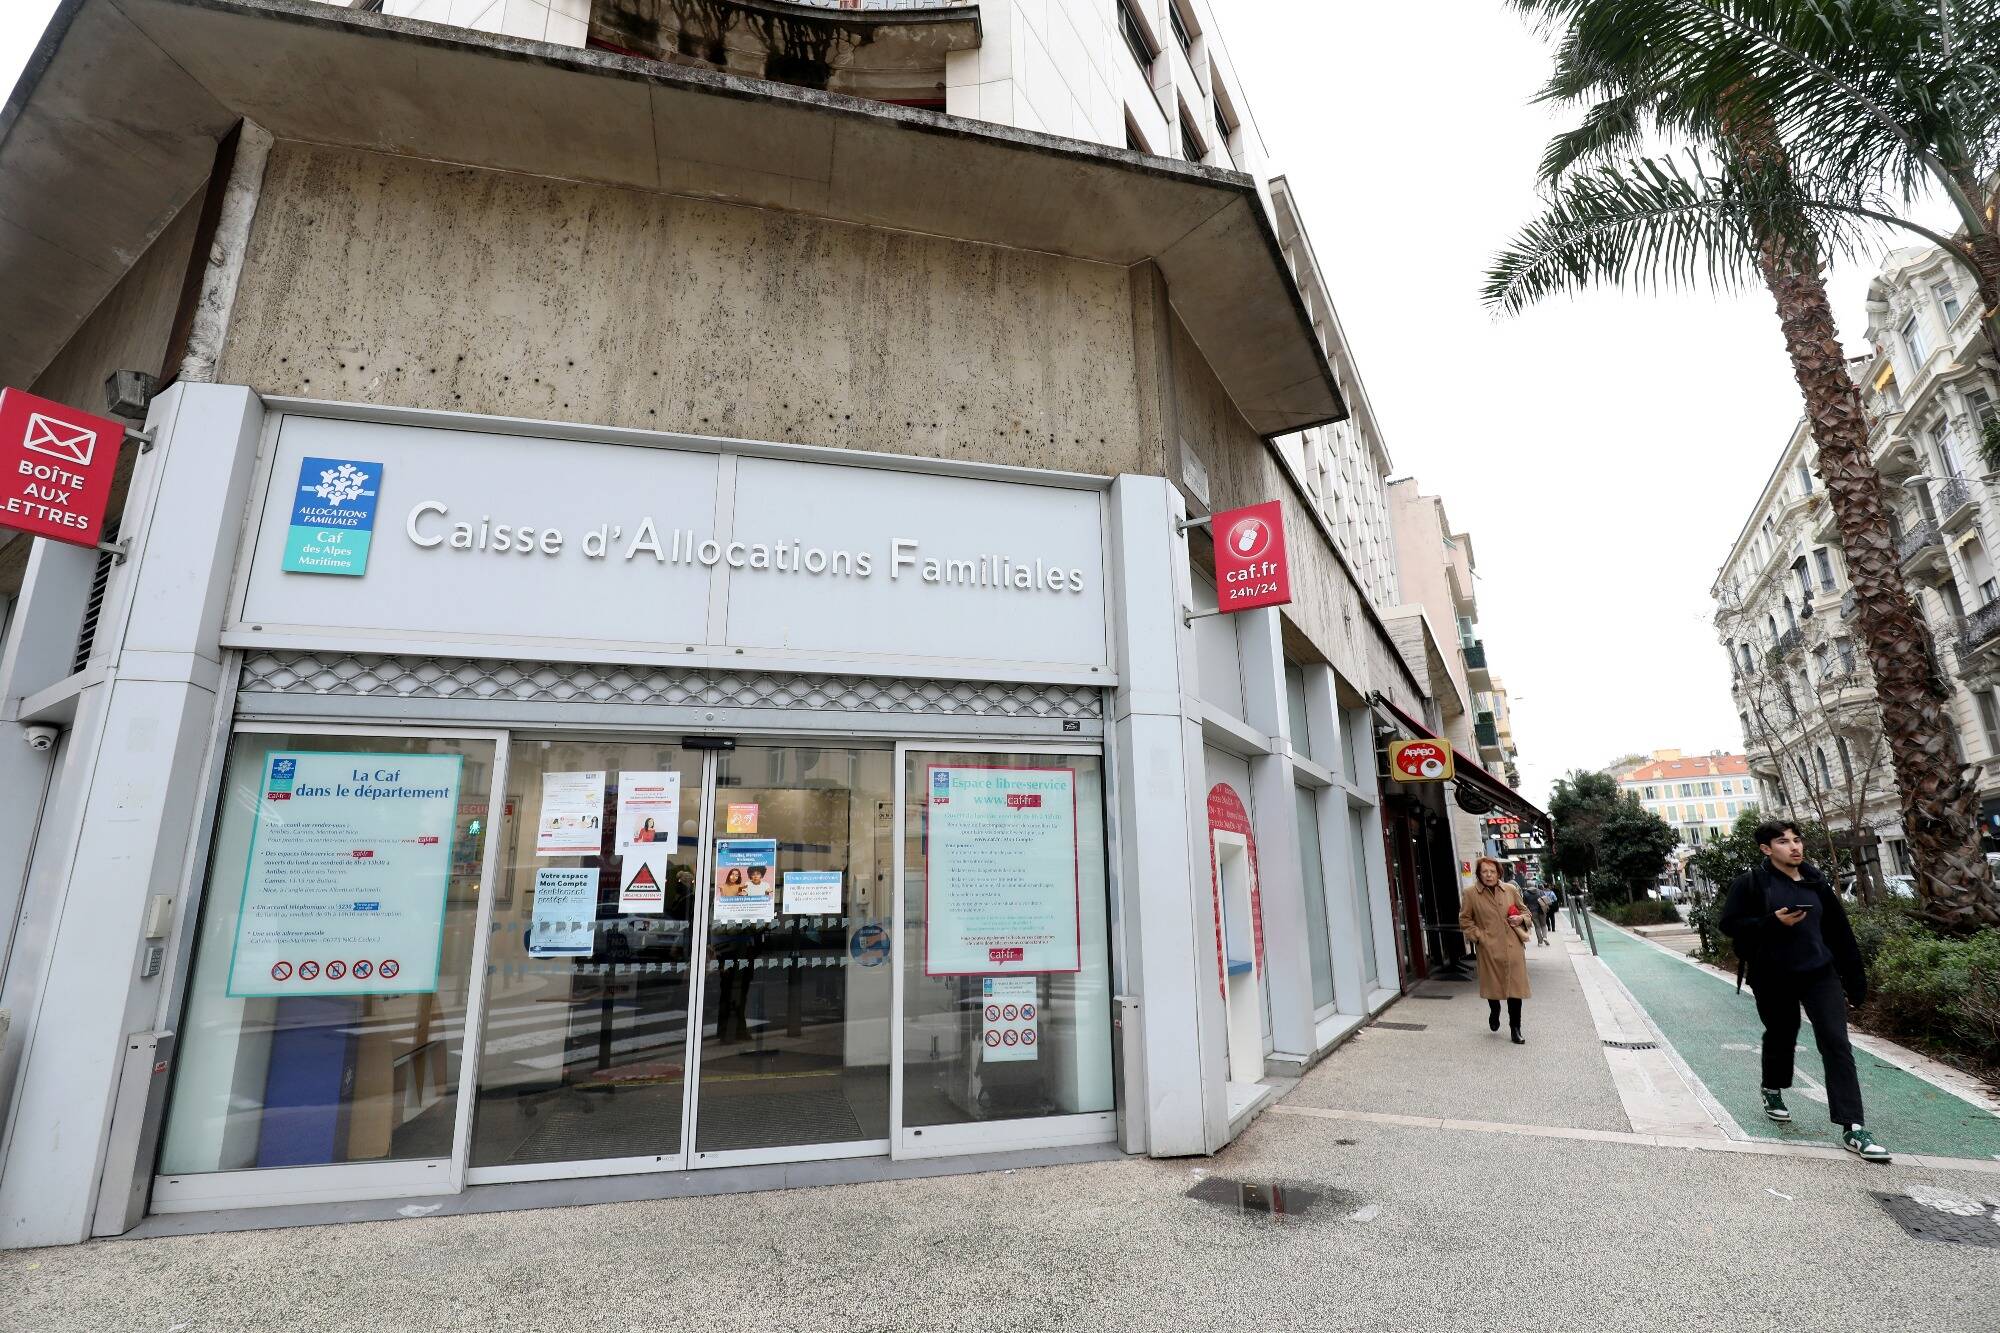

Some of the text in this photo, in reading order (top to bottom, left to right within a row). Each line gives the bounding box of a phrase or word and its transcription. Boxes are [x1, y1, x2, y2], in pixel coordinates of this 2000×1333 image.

[18, 459, 85, 491] BOÎTE
[23, 481, 71, 506] AUX
[299, 507, 367, 520] ALLOCATIONS
[304, 515, 358, 527] FAMILIALES
[316, 531, 344, 545] Caf
[303, 544, 352, 558] des Alpes
[404, 500, 1085, 593] Caisse d'Allocations Familiales
[299, 556, 352, 568] Maritimes
[1226, 562, 1277, 582] caf.fr
[1230, 582, 1277, 599] 24h/24
[353, 769, 401, 782] La Caf
[952, 778, 1067, 790] Espace libre-service
[296, 784, 331, 797] dans
[336, 784, 350, 797] le
[354, 784, 449, 800] département
[1501, 824, 1519, 833] OR
